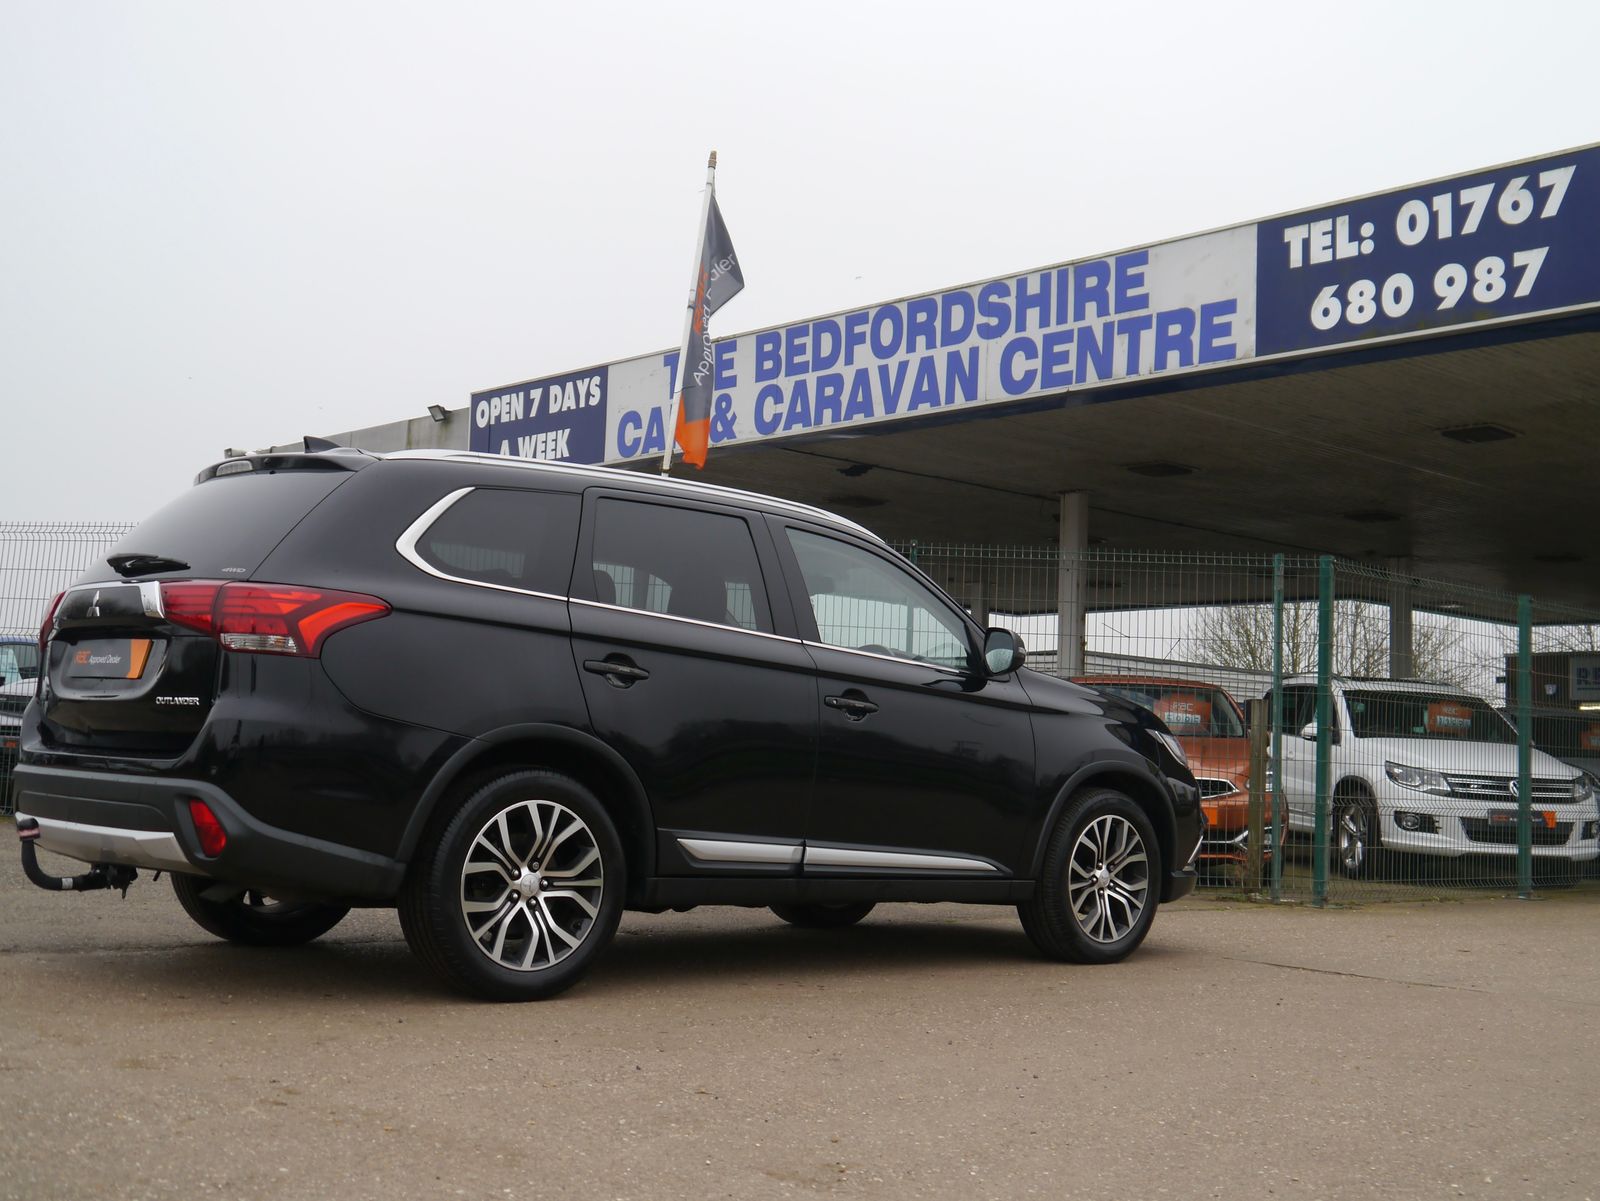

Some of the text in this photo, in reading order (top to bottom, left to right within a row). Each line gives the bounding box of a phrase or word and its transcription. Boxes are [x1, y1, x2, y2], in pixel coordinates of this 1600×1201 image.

[1283, 164, 1577, 269] TEL: 01767
[663, 340, 737, 400] TE
[755, 249, 1150, 384] BEDFORDSHIRE
[1310, 246, 1550, 331] 680 987
[475, 375, 601, 429] OPEN 7 DAYS
[616, 298, 1238, 459] CA & CARAVAN CENTRE
[500, 428, 571, 461] A WEEK
[155, 696, 200, 706] OUTLANDER
